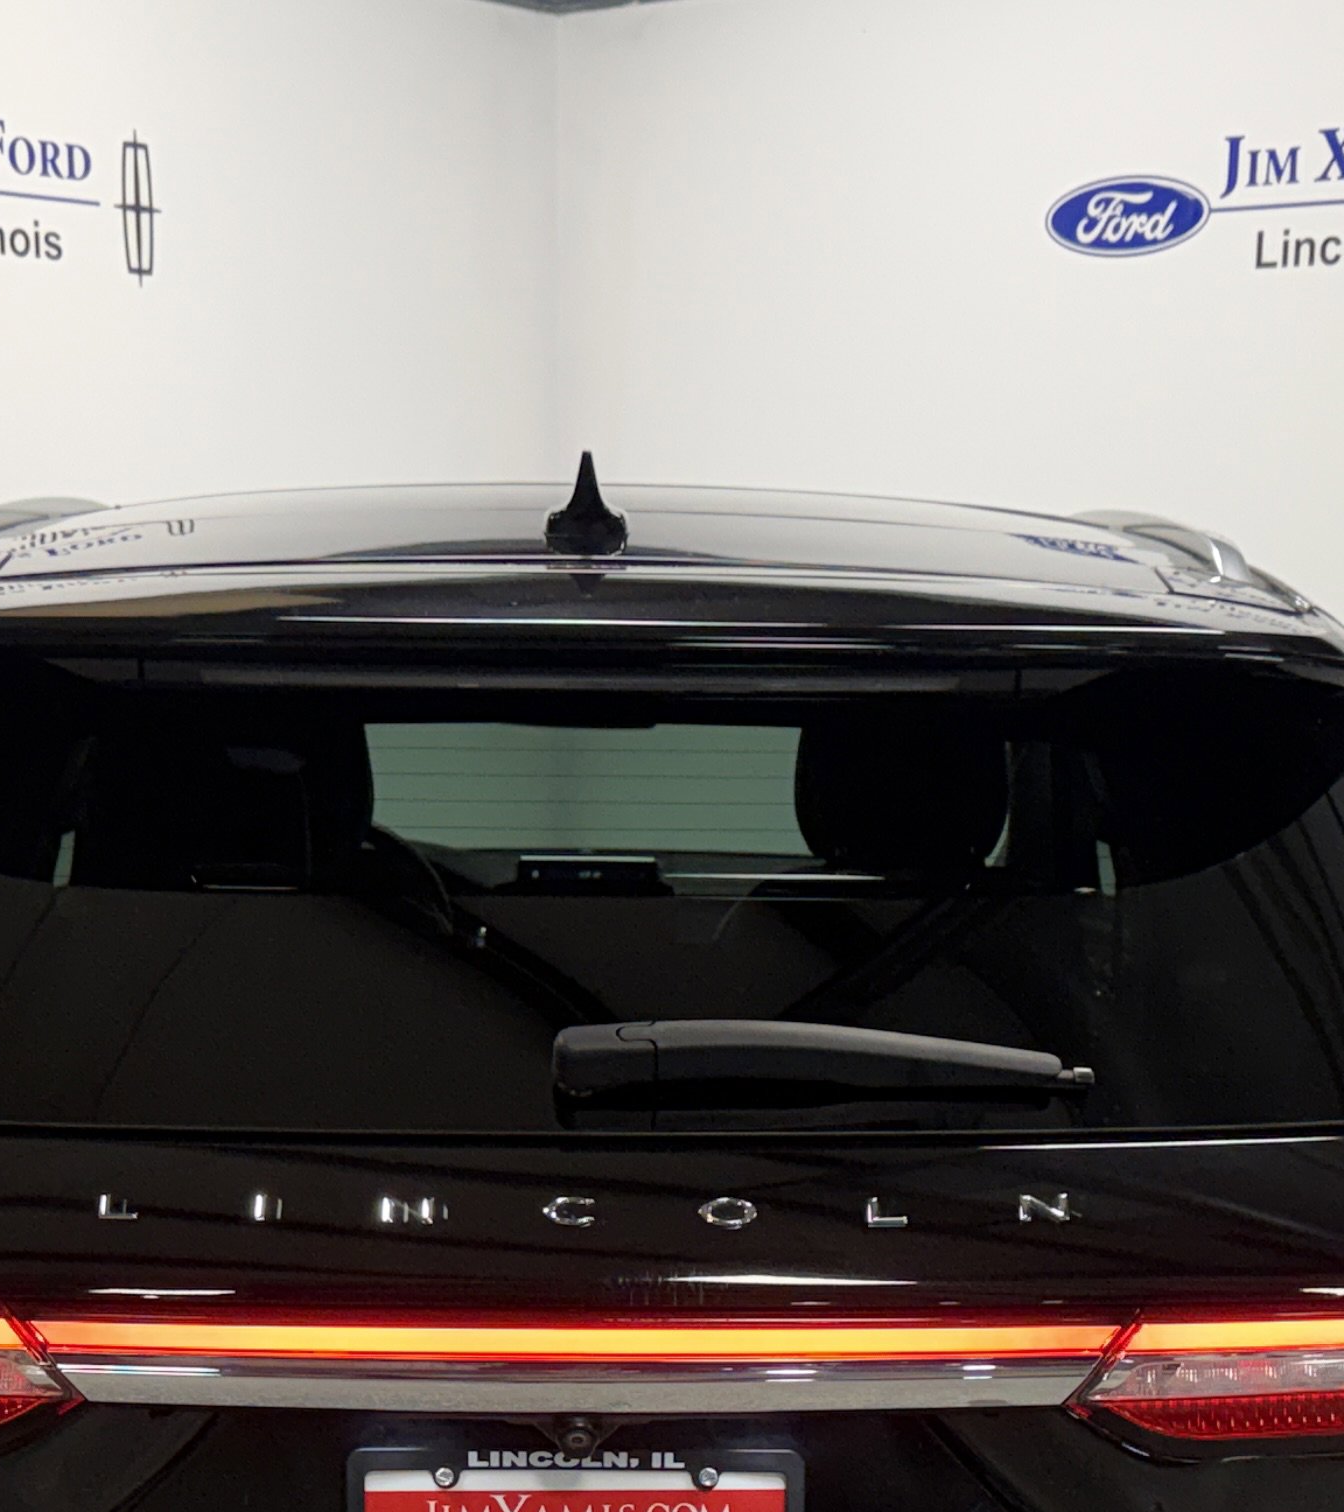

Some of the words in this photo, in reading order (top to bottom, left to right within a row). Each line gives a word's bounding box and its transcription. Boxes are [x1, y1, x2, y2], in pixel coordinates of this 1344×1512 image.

[1220, 135, 1300, 199] JIM
[1076, 190, 1178, 244] Ford
[99, 1192, 1071, 1228] LINCOLN
[651, 1451, 686, 1469] IL
